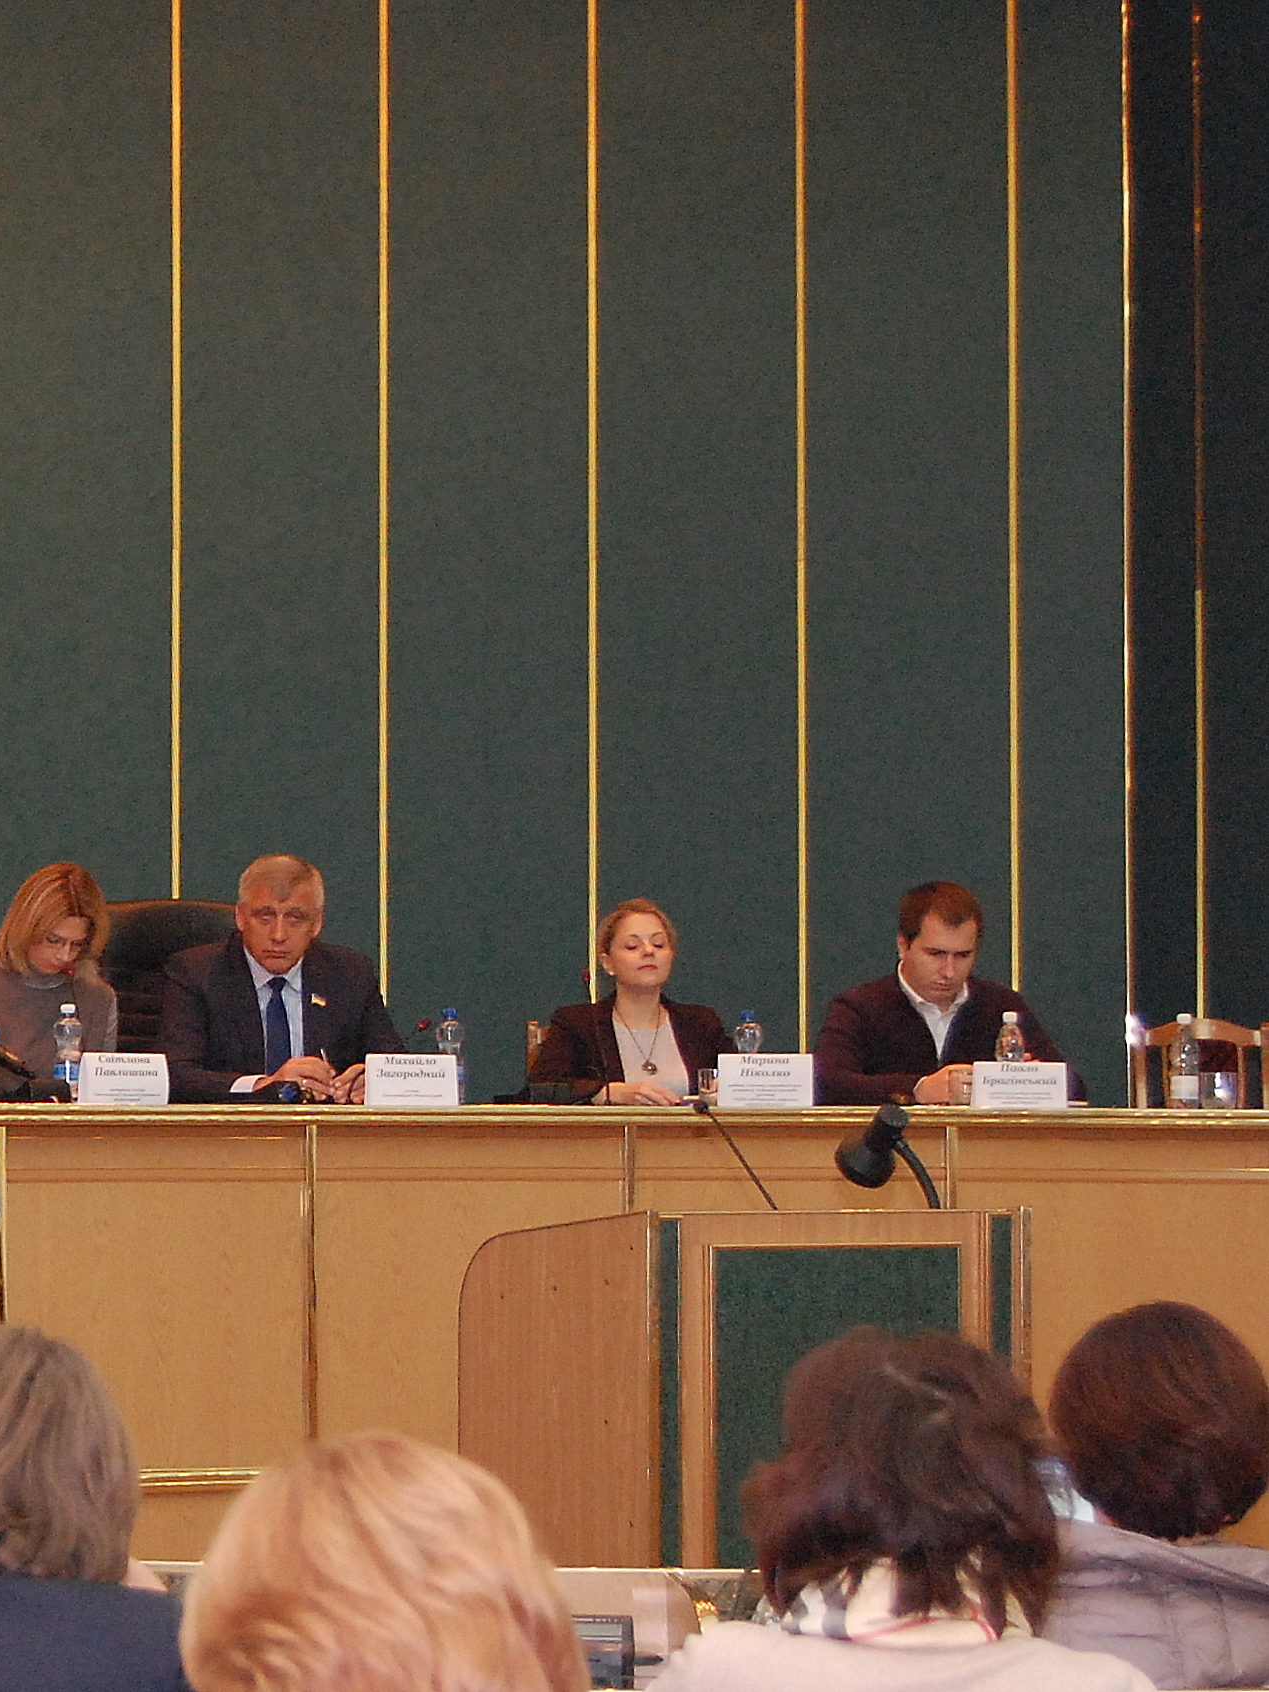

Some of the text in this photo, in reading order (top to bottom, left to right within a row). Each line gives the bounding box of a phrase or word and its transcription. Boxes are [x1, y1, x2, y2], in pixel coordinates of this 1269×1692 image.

[384, 1056, 436, 1065] Михайло
[740, 1056, 789, 1066] Марина
[376, 1068, 445, 1079] Загородний
[740, 1068, 791, 1077] Ніколко
